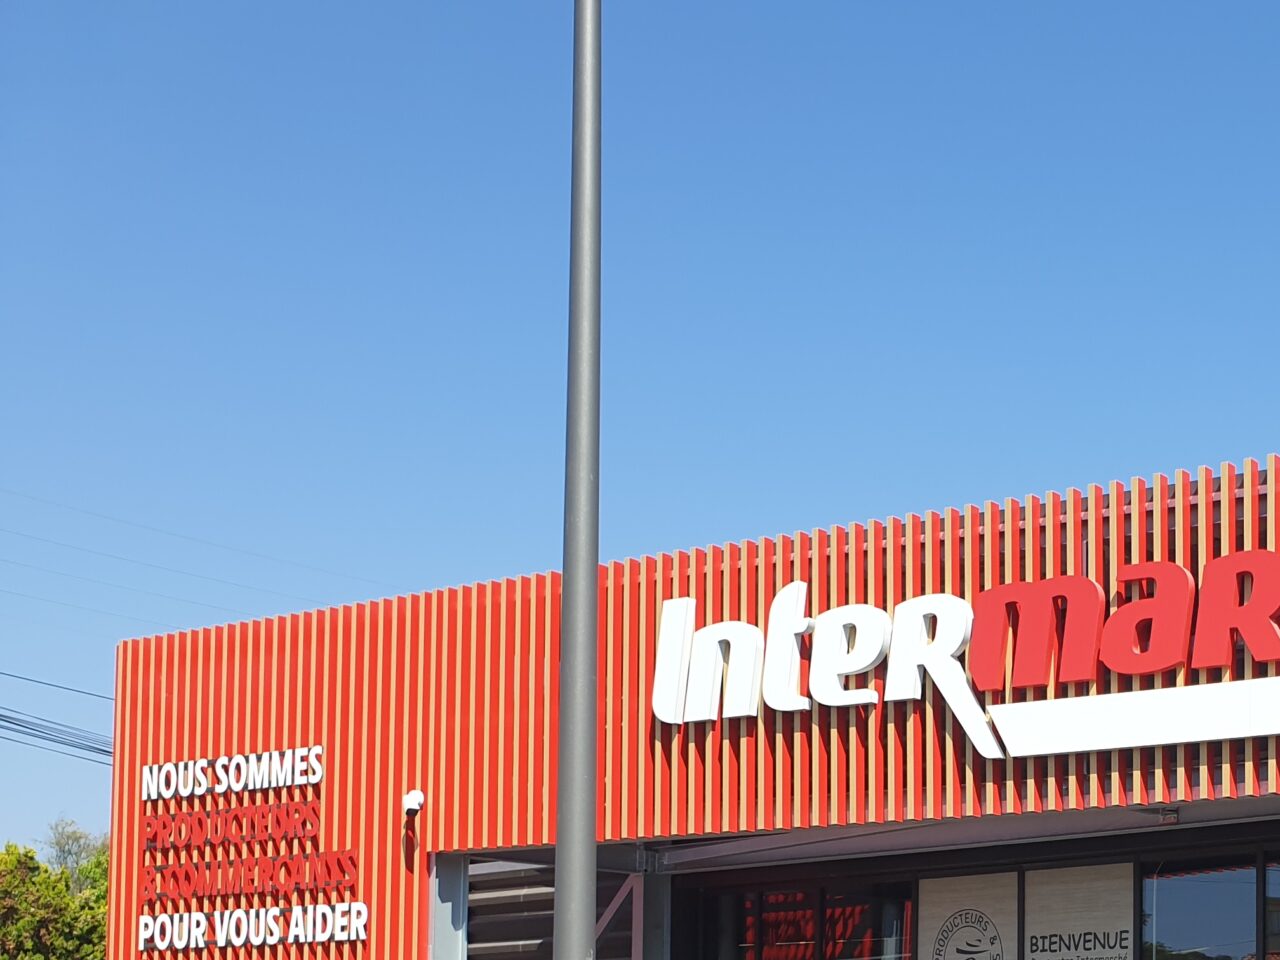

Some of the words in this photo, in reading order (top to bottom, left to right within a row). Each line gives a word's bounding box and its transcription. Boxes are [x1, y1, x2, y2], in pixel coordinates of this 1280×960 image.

[141, 757, 208, 801] NOUS
[215, 745, 324, 793] SOMMES
[141, 800, 321, 850] PRODUCTEURS
[141, 864, 158, 900] &
[165, 848, 359, 899] COMMERÇANTS
[138, 912, 207, 950] POUR
[213, 908, 280, 948] VOUS
[288, 902, 368, 943] AIDER
[989, 934, 998, 946] &
[1030, 930, 1130, 954] BIENVENUE
